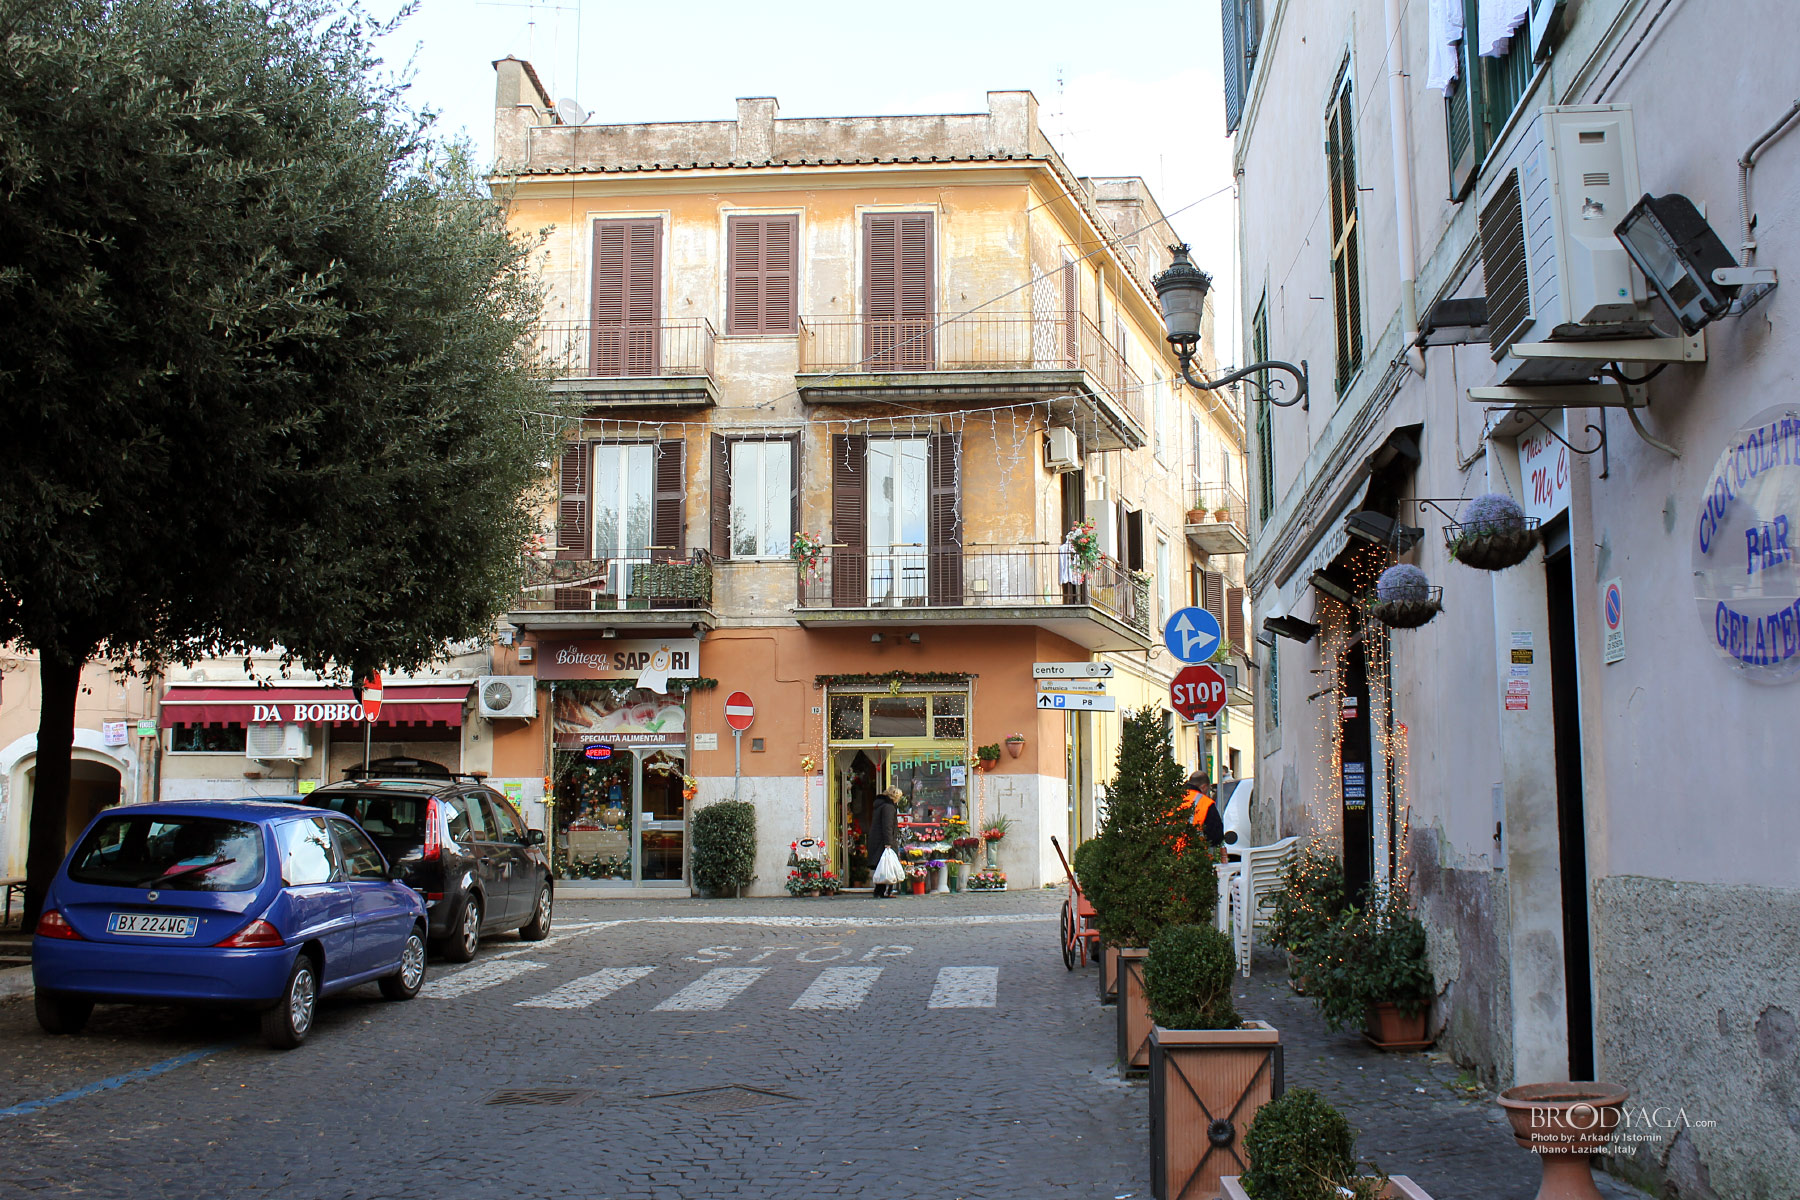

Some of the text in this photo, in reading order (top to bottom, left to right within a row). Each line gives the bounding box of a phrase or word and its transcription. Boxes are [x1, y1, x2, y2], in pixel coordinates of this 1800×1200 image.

[1521, 436, 1543, 464] This
[1531, 466, 1553, 509] My
[1745, 514, 1790, 575] BAR
[556, 649, 607, 668] Bottega
[613, 651, 690, 671] SAPORI
[1173, 681, 1223, 705] STOP
[252, 704, 365, 721] DA BOBBO
[580, 733, 666, 743] SPECIALITÀ ALIMENTARI
[890, 750, 940, 775] PIANTE
[118, 915, 137, 930] BX
[140, 917, 186, 933] 224WG
